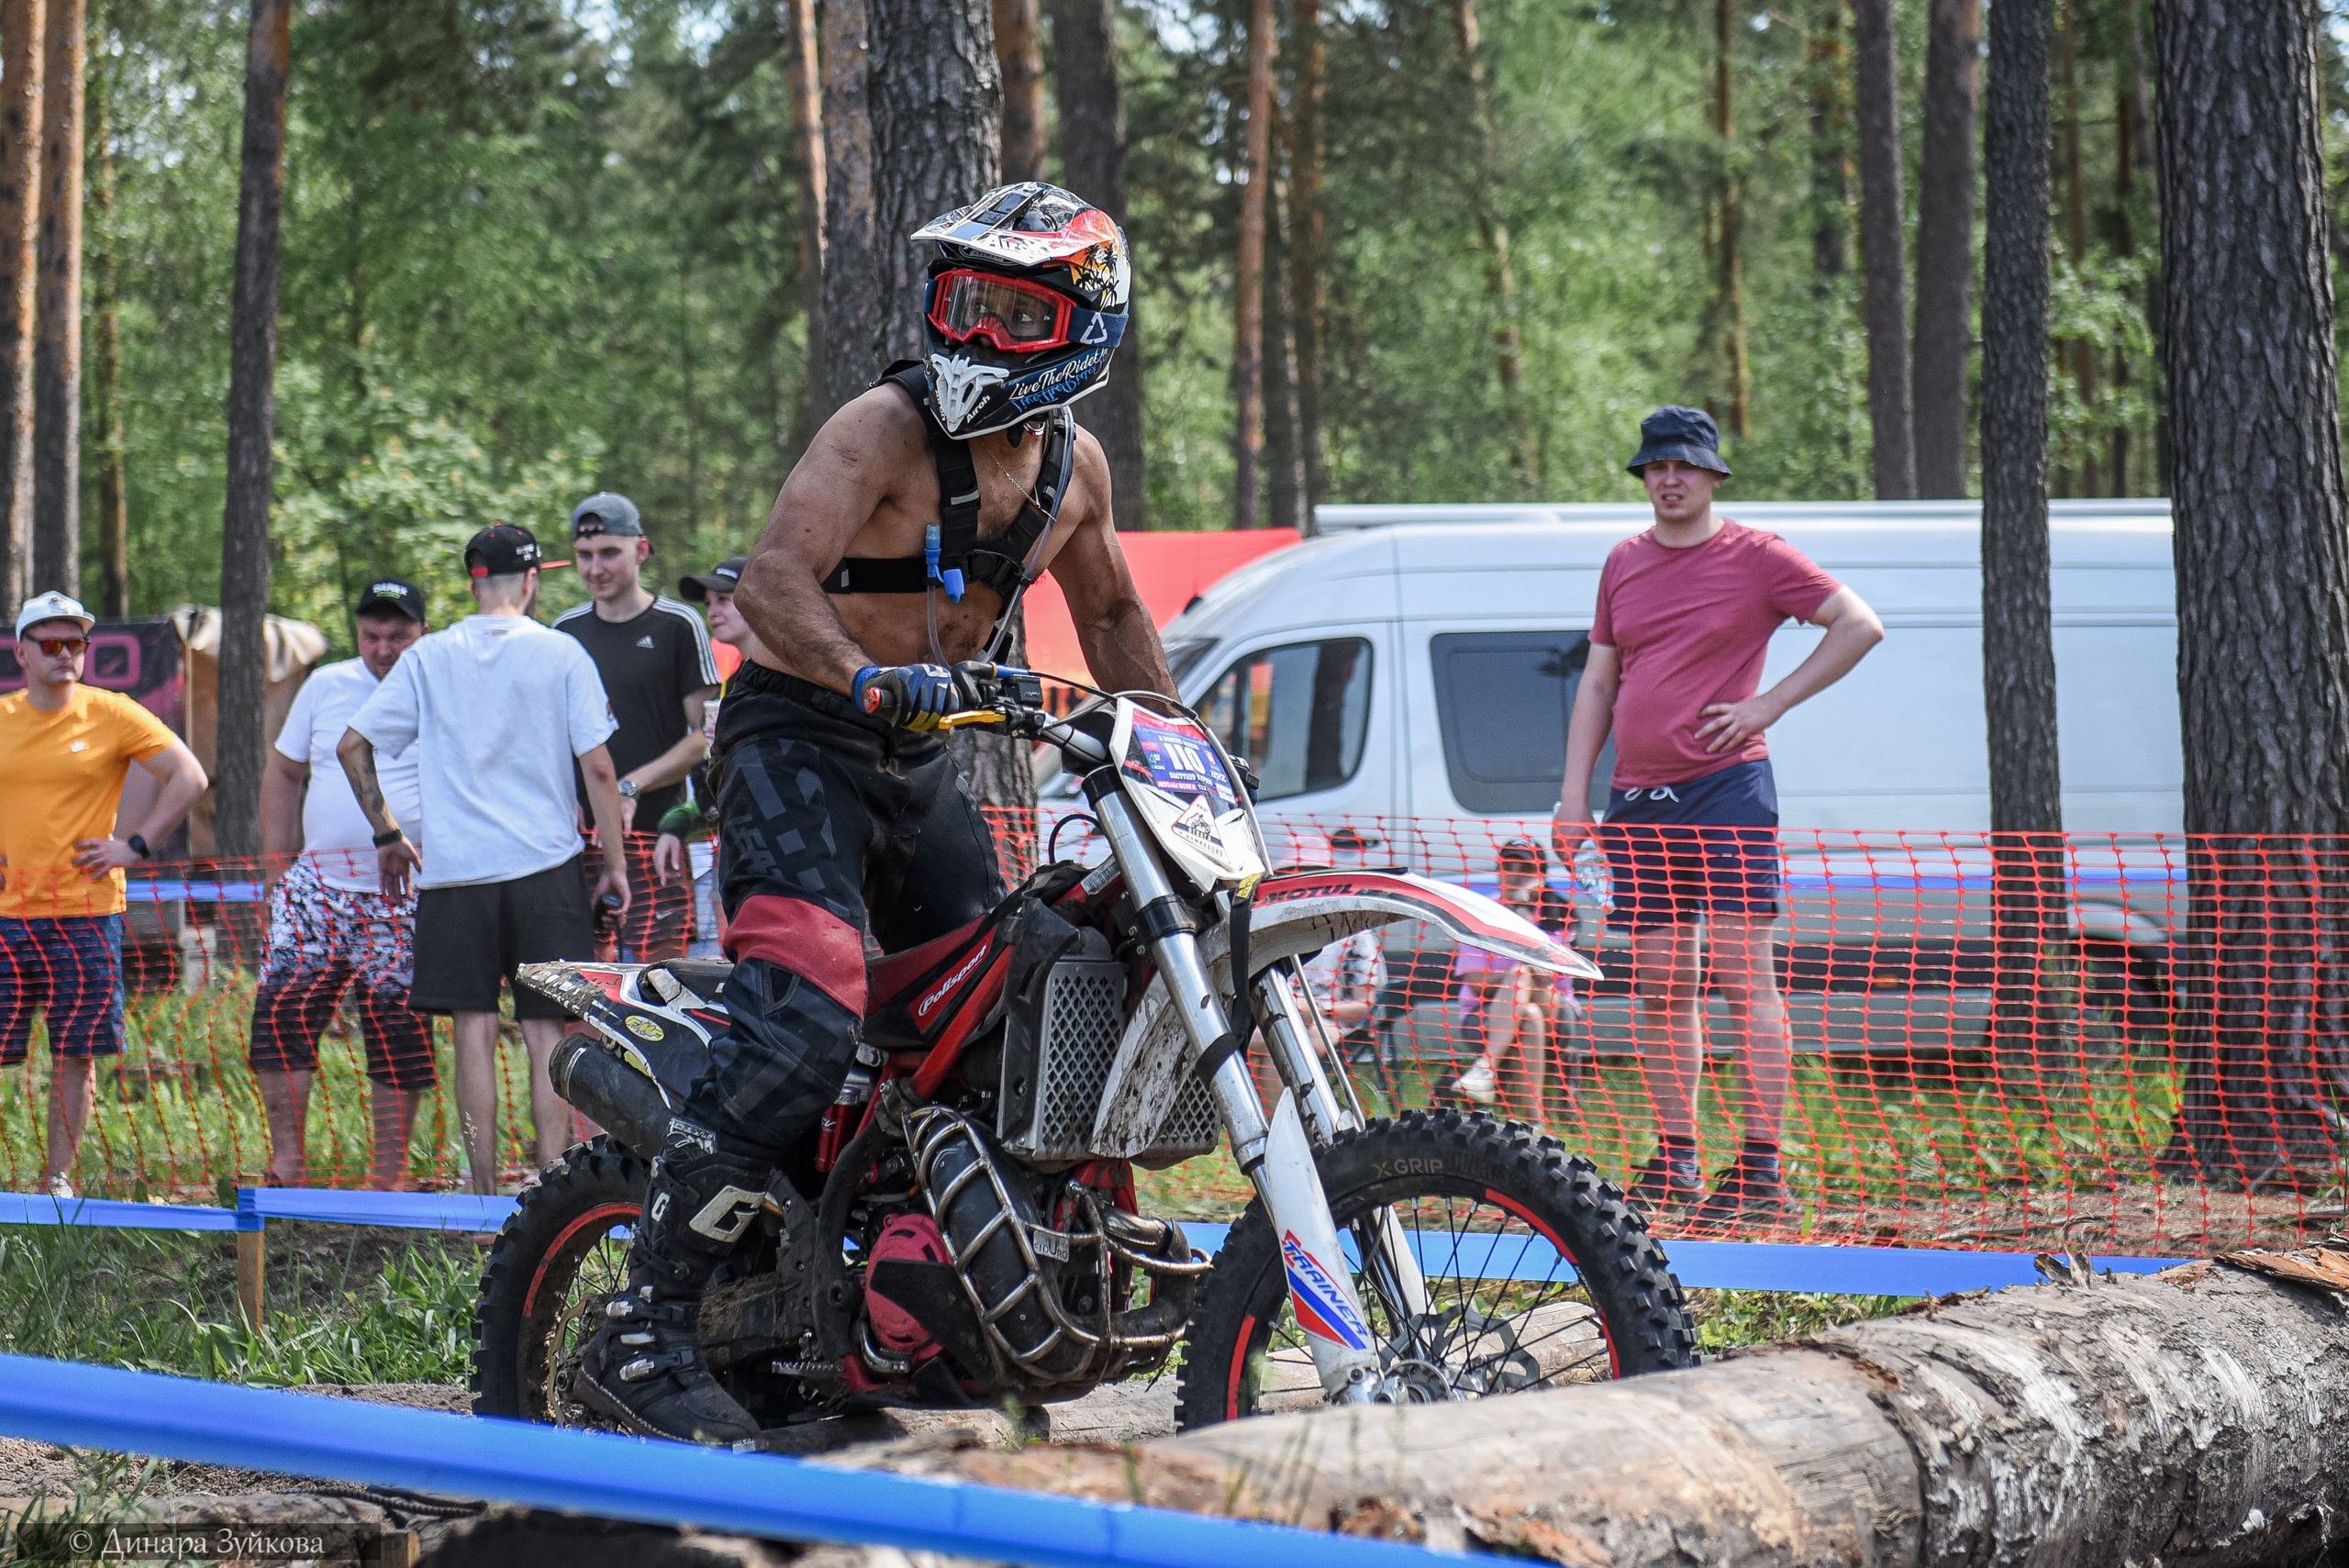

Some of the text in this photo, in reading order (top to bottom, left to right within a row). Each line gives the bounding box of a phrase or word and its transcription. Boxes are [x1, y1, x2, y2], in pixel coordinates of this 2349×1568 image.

[966, 395, 991, 424] Airoh
[1163, 742, 1207, 775] 110
[1264, 884, 1353, 903] MOTUL
[918, 943, 987, 1017] Polisport
[625, 1016, 665, 1040] FMF
[1394, 1157, 1443, 1175] GRIP
[1283, 1238, 1368, 1338] TRAINER
